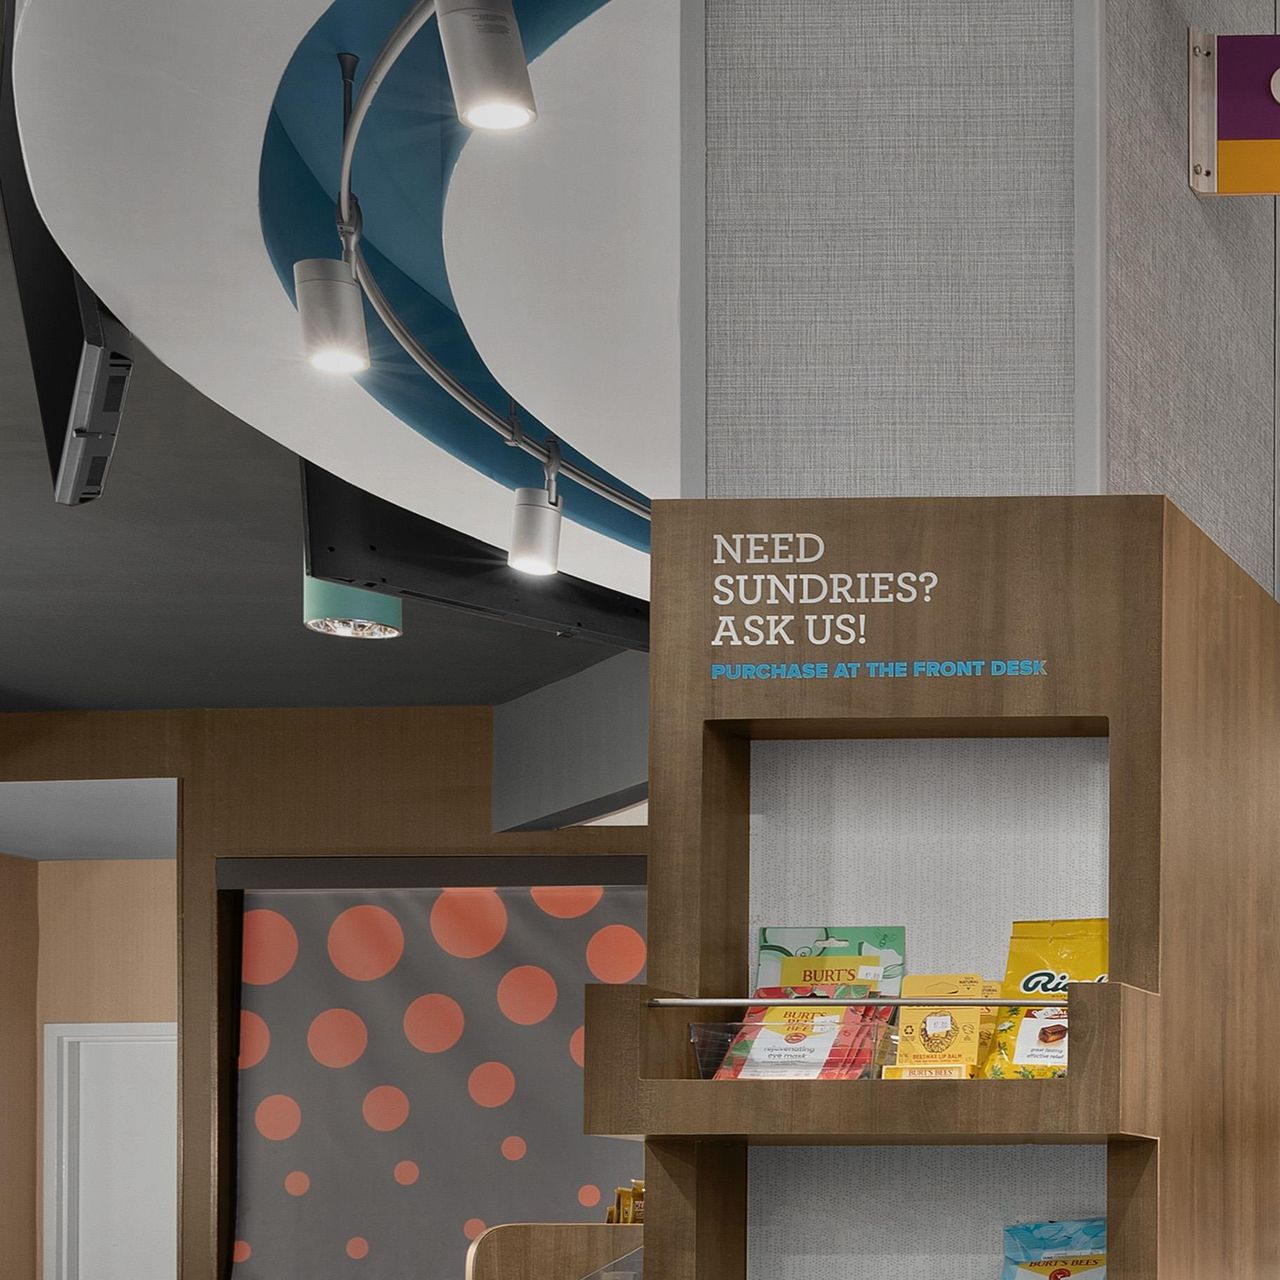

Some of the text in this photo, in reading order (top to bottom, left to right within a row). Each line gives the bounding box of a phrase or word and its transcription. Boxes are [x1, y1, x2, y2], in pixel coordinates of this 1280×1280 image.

[713, 533, 825, 565] NEED
[713, 571, 939, 605] SUNDRIES?
[711, 614, 867, 646] ASK US!
[711, 659, 1048, 679] PURCHASE AT THE FRONT DESK
[803, 968, 856, 982] BURT'S
